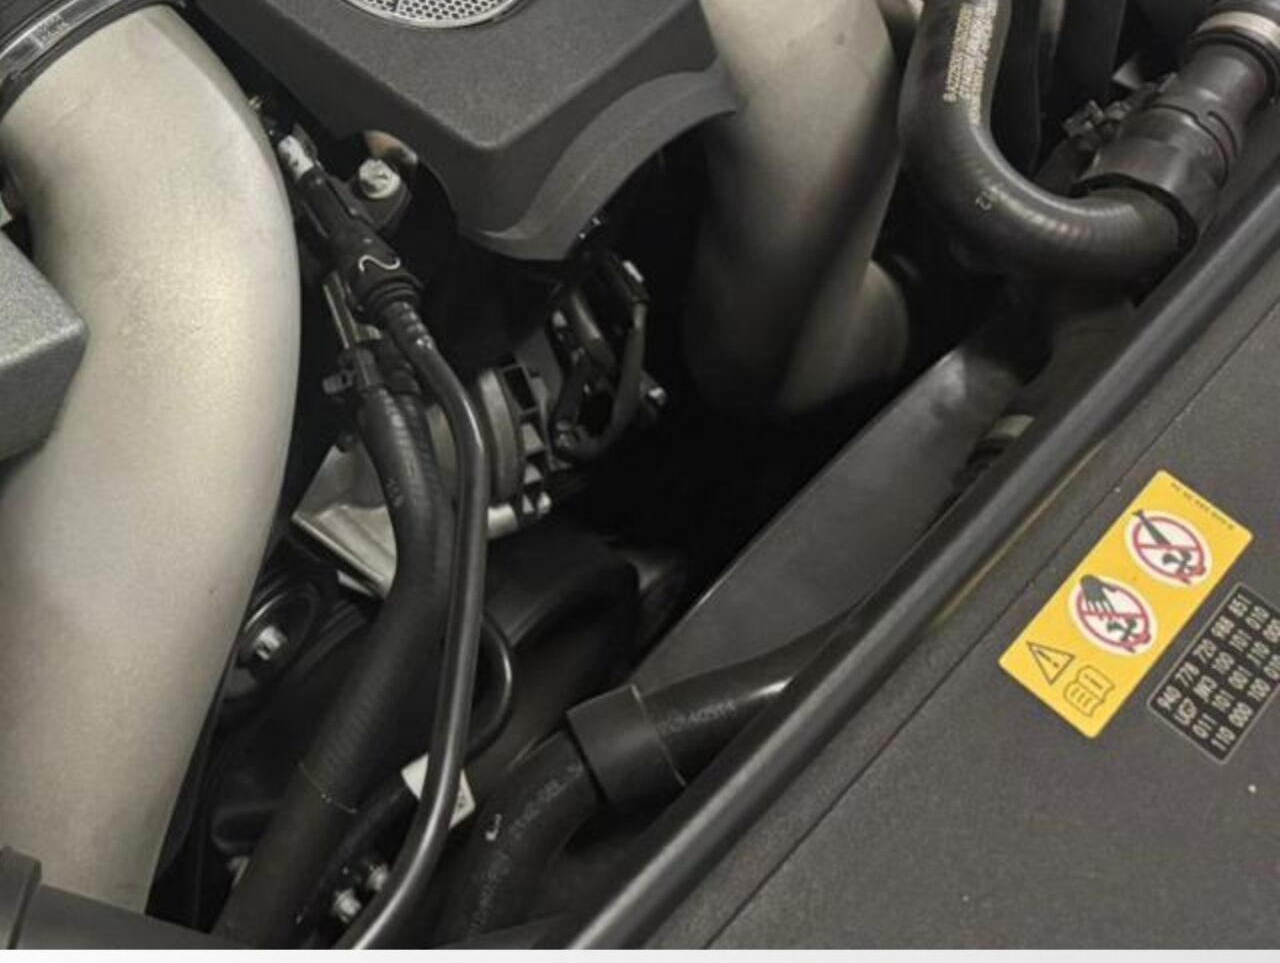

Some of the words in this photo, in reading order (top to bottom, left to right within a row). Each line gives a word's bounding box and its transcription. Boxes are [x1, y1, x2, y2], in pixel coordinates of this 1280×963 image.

[1212, 652, 1234, 673] 100
[1229, 629, 1251, 651] 101
[1245, 606, 1269, 629] 010
[1193, 713, 1216, 738] 011
[1212, 690, 1234, 711] 101
[1228, 666, 1251, 689] 001
[1211, 726, 1235, 750] 110
[1229, 702, 1252, 727] 000
[1248, 678, 1270, 701] 100
